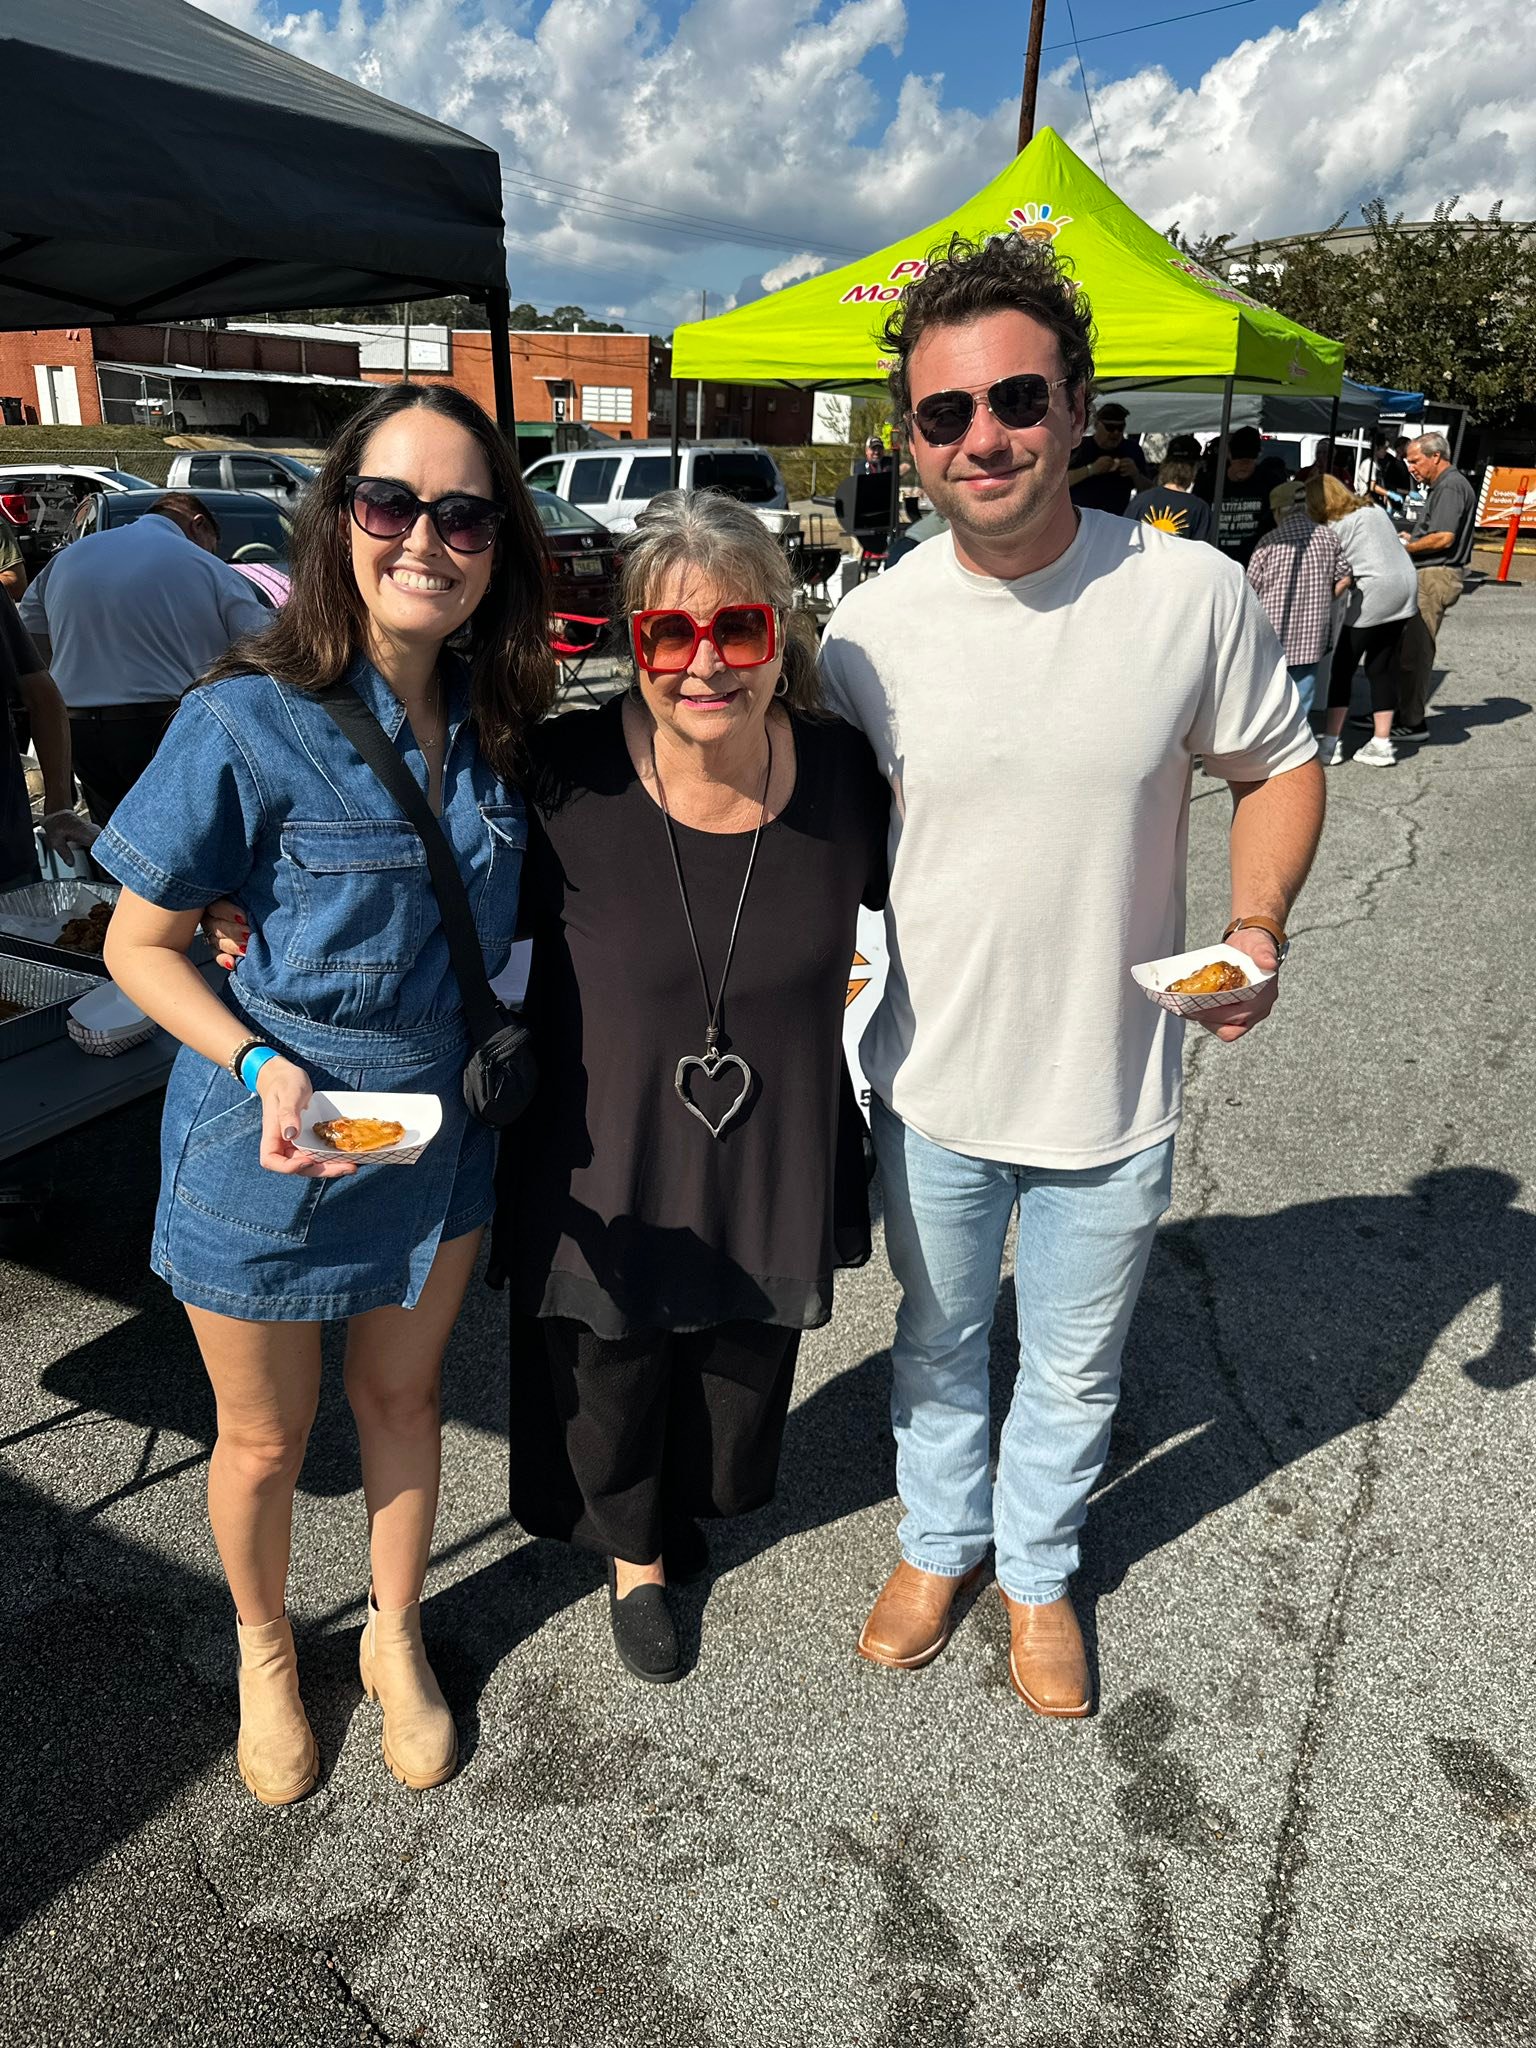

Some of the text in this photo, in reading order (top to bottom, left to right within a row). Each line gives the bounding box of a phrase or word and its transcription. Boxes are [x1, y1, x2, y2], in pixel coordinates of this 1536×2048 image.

[889, 260, 928, 280] Pi
[842, 285, 899, 302] Mo
[859, 1089, 872, 1107] 5
